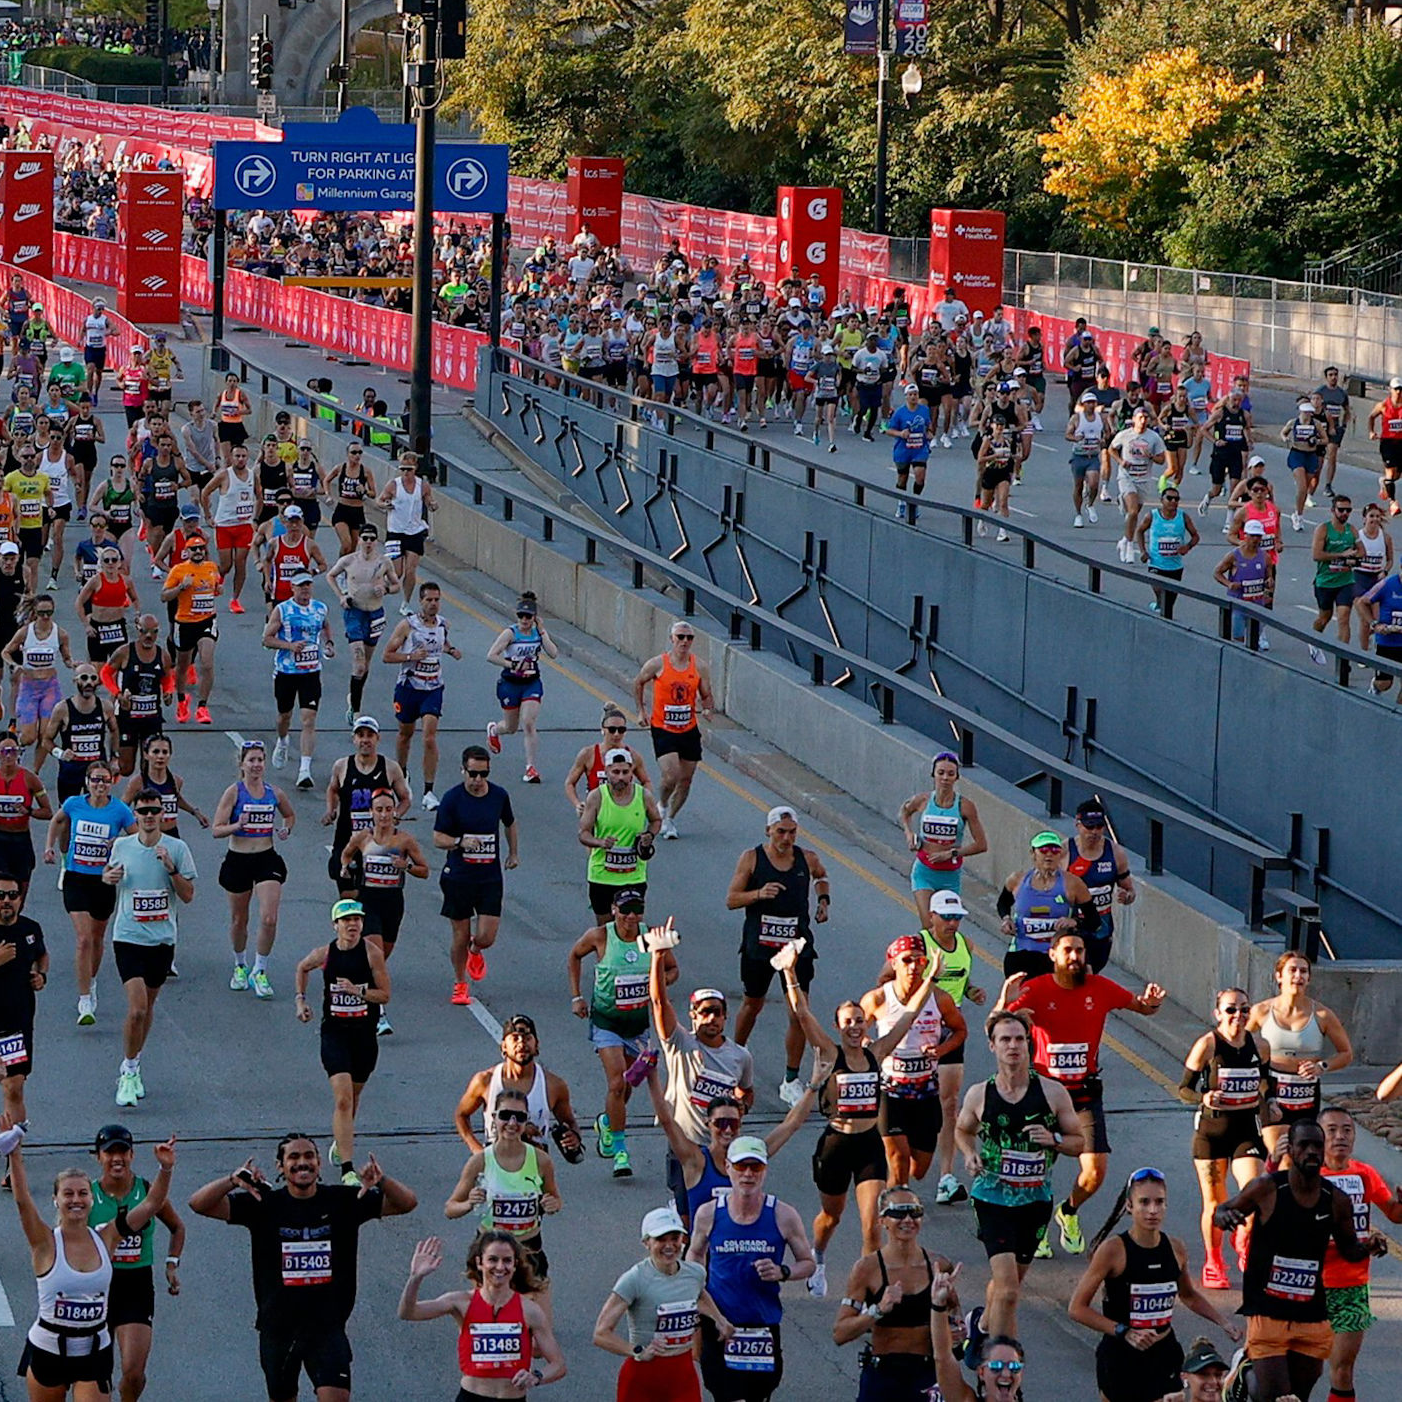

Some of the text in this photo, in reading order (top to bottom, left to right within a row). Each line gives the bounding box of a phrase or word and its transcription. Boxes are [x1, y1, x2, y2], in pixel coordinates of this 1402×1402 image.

[904, 23, 928, 39] 20
[903, 39, 927, 55] 26
[291, 151, 414, 164] TURN RIGHT AT LIG
[20, 162, 41, 171] RUN
[308, 168, 415, 180] FOR PARKING AT
[317, 187, 415, 201] Millennium Garag
[19, 203, 41, 214] RUN
[807, 198, 828, 221] G
[965, 232, 999, 241] Health Care
[19, 245, 40, 255] RUN
[806, 241, 826, 265] G
[134, 897, 168, 911] D9588
[761, 925, 796, 937] D4556
[1050, 1053, 1087, 1067] D8446
[840, 1083, 877, 1098] D9306
[1002, 1163, 1045, 1177] D18542
[494, 1200, 537, 1216] D2475
[284, 1254, 331, 1270] D15403
[1272, 1271, 1317, 1288] D22479
[56, 1304, 103, 1319] D18447
[472, 1336, 521, 1353] D13483
[727, 1340, 774, 1354] C12676
